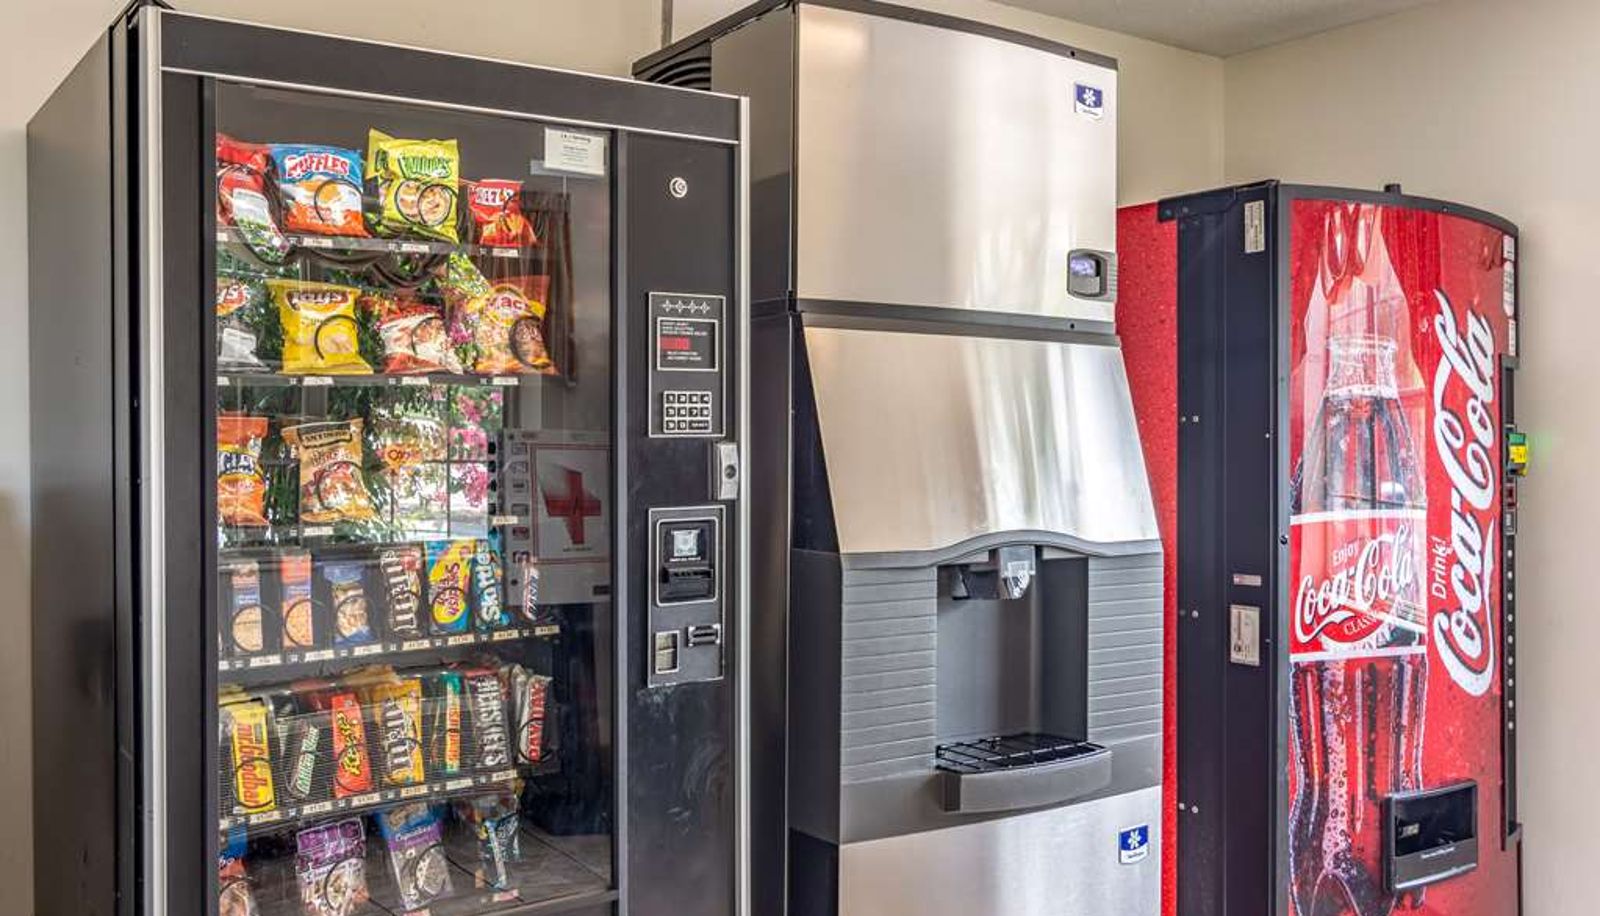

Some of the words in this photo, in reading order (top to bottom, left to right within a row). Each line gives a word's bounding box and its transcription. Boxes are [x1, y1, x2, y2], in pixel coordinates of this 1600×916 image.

[1433, 288, 1495, 697] Coca-Cola
[1295, 524, 1413, 644] Coca-Cola
[1431, 535, 1453, 600] Drink!
